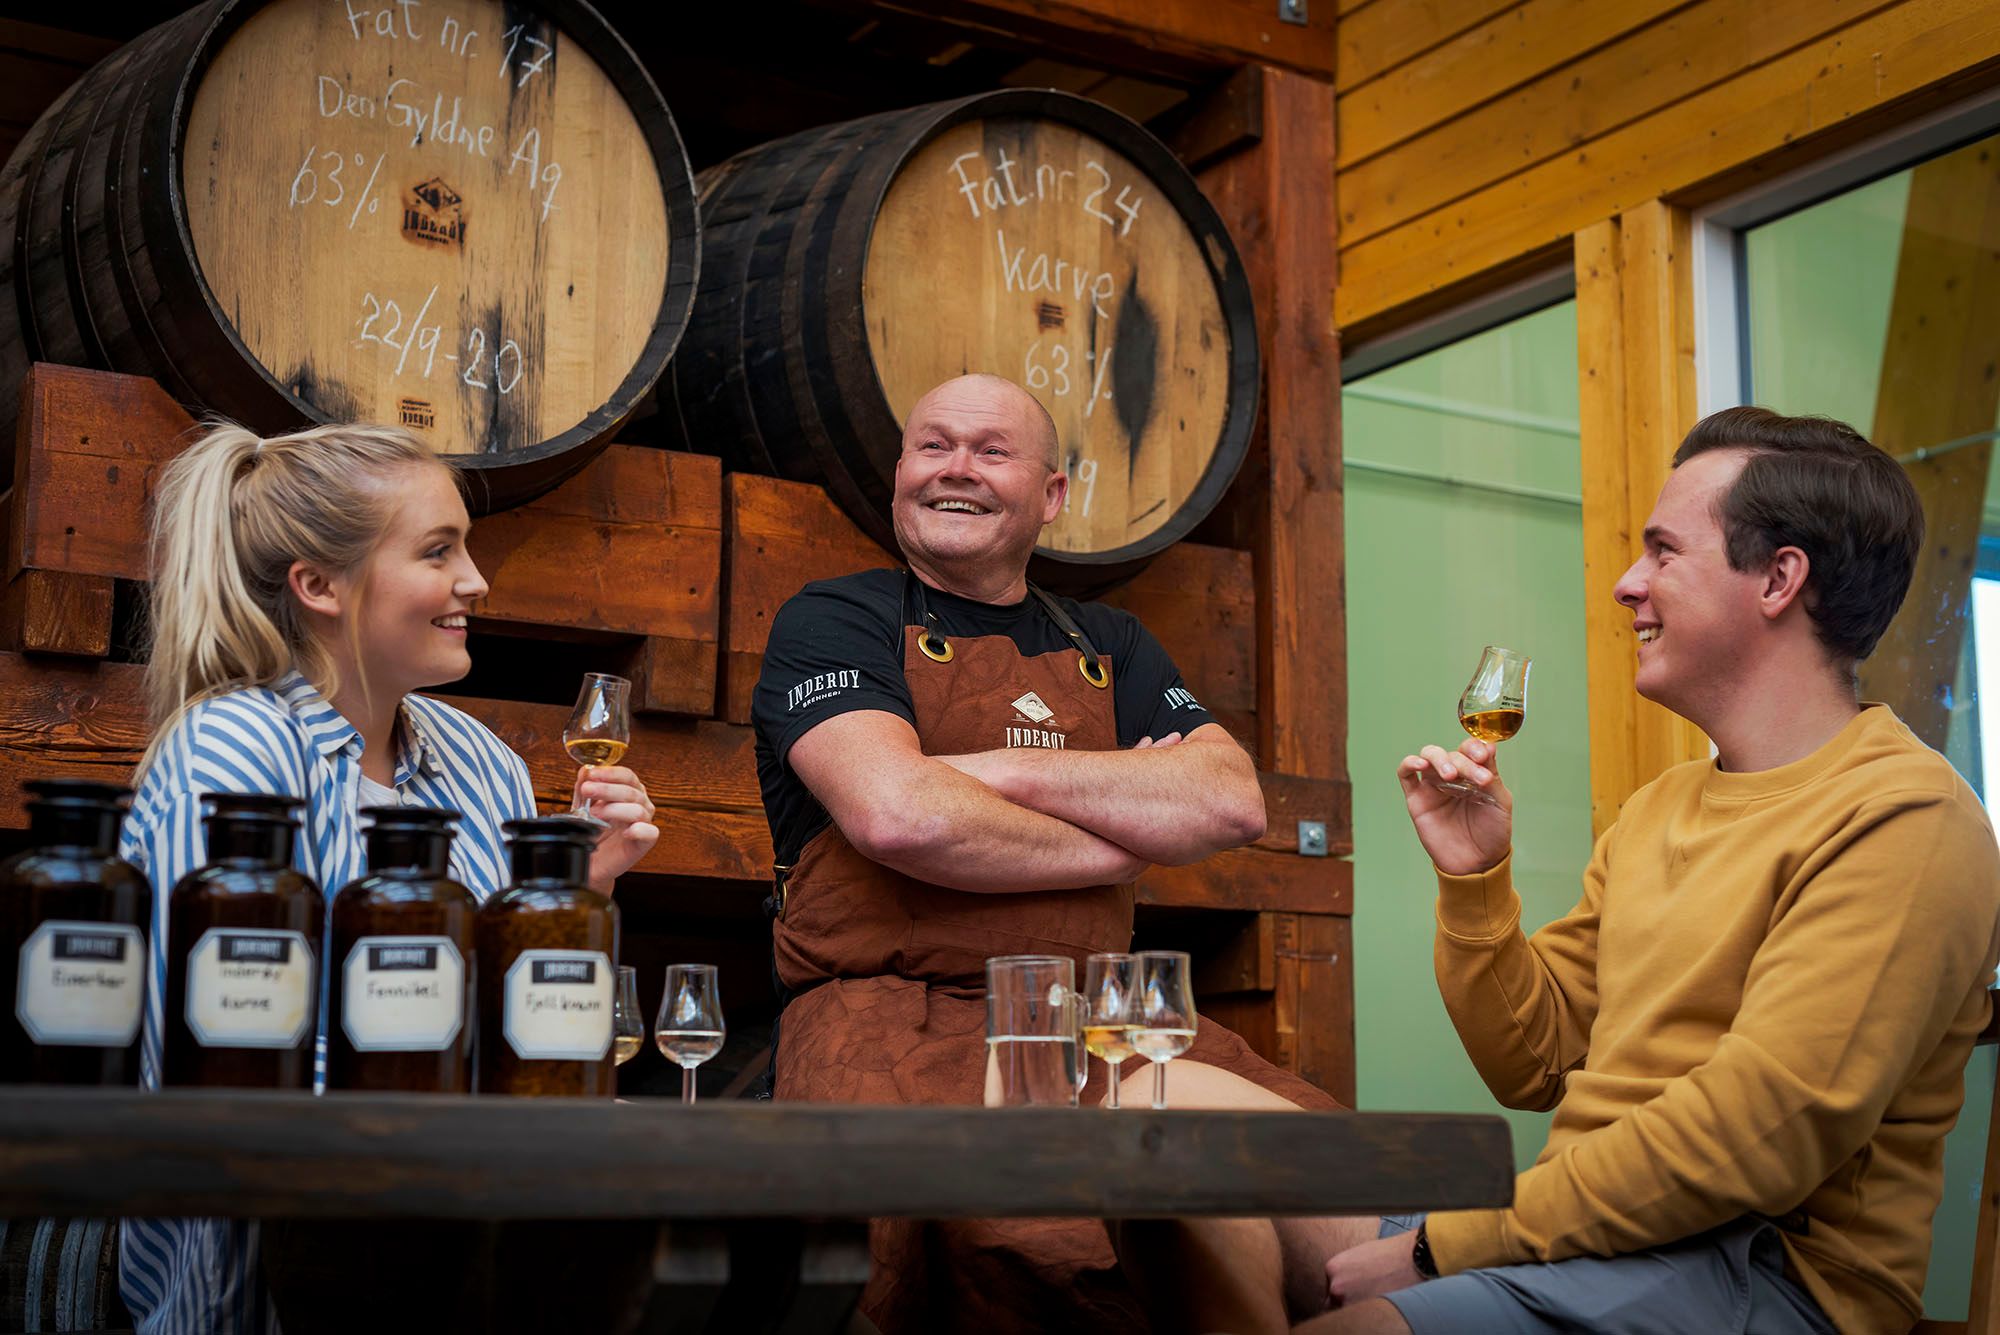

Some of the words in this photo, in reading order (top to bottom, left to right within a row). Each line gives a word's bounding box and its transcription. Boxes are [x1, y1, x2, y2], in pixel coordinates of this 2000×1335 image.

[499, 24, 553, 89] 17
[318, 75, 376, 119] Den
[384, 78, 495, 157] Gyldne
[1083, 160, 1143, 236] 24
